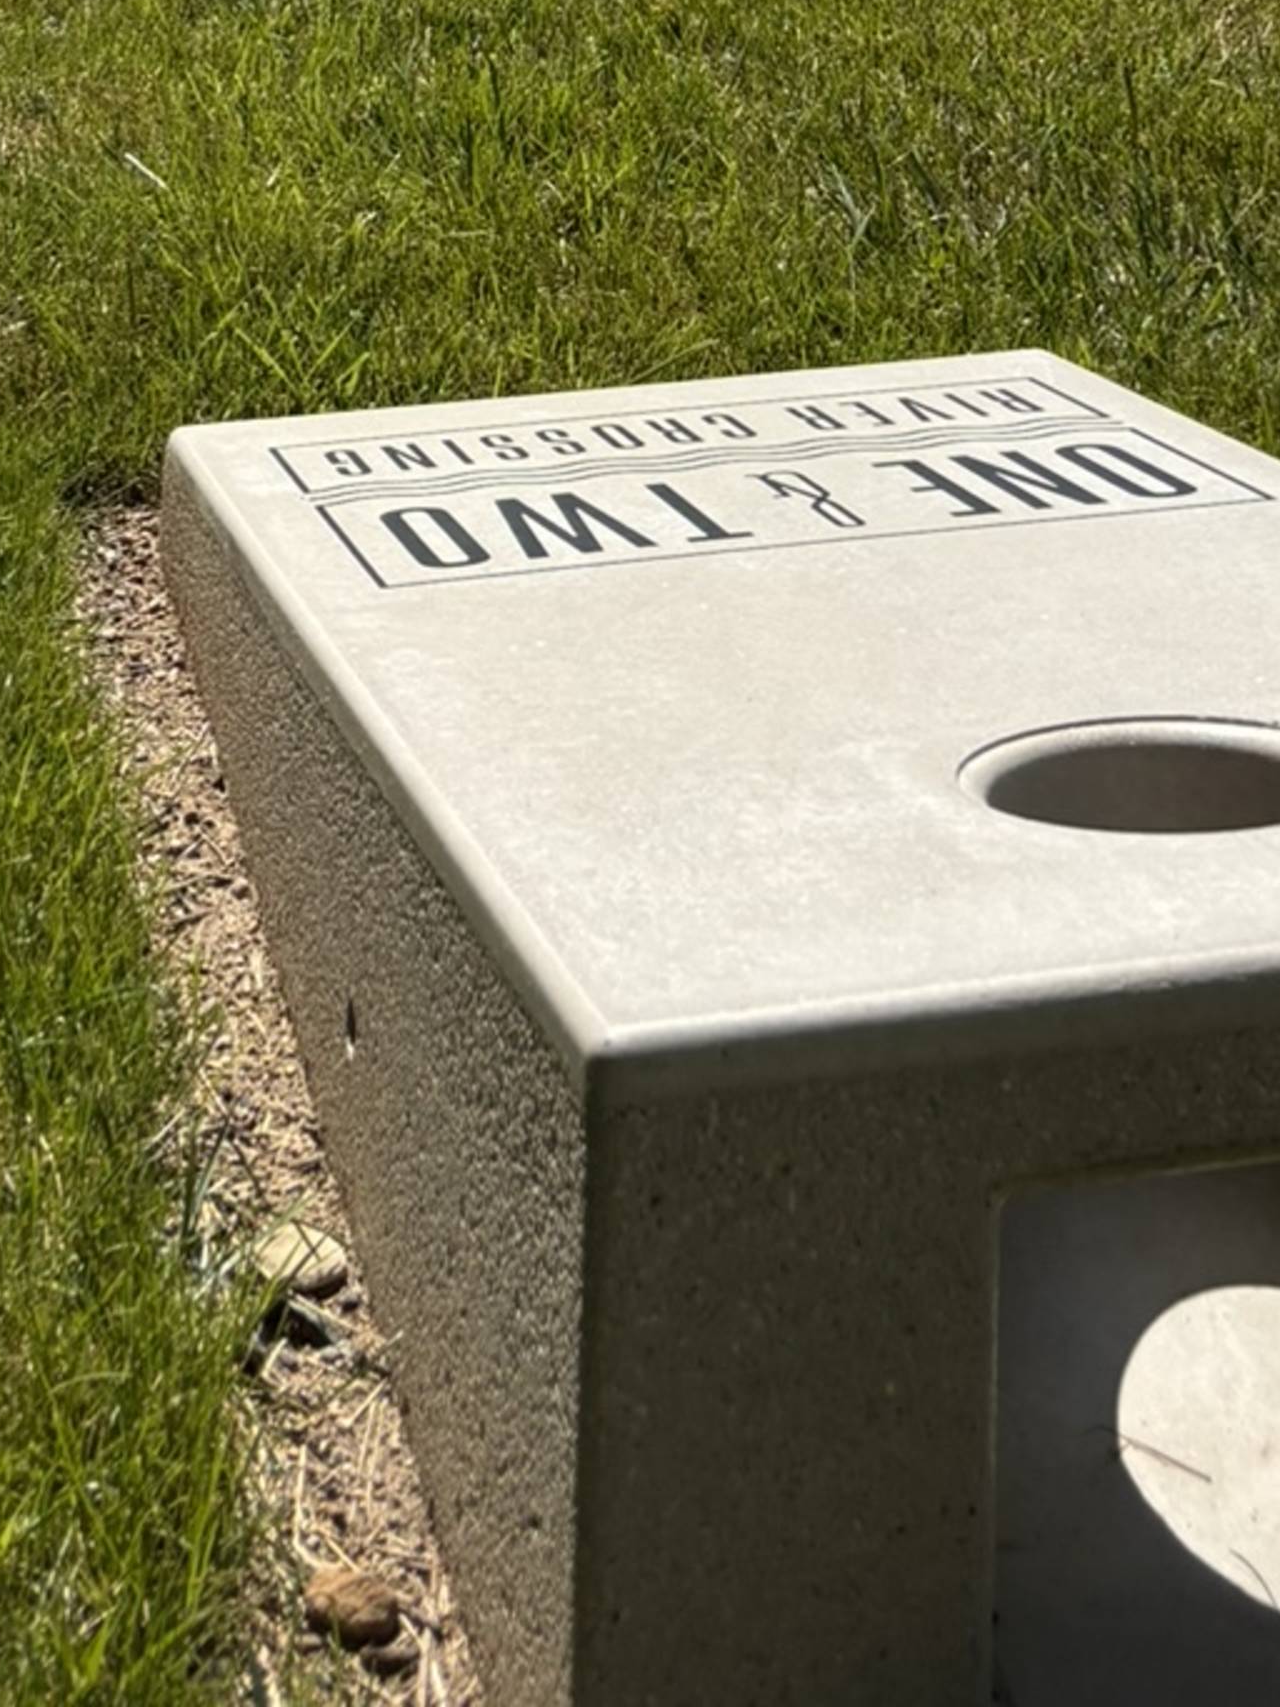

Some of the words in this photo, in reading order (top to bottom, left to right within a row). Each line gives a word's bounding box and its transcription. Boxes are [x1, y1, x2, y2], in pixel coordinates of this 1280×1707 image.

[785, 388, 1046, 430] RIVER
[323, 412, 758, 477] CROSSING
[745, 469, 867, 528] &
[872, 443, 1199, 518] ONE
[379, 482, 755, 569] TWO
